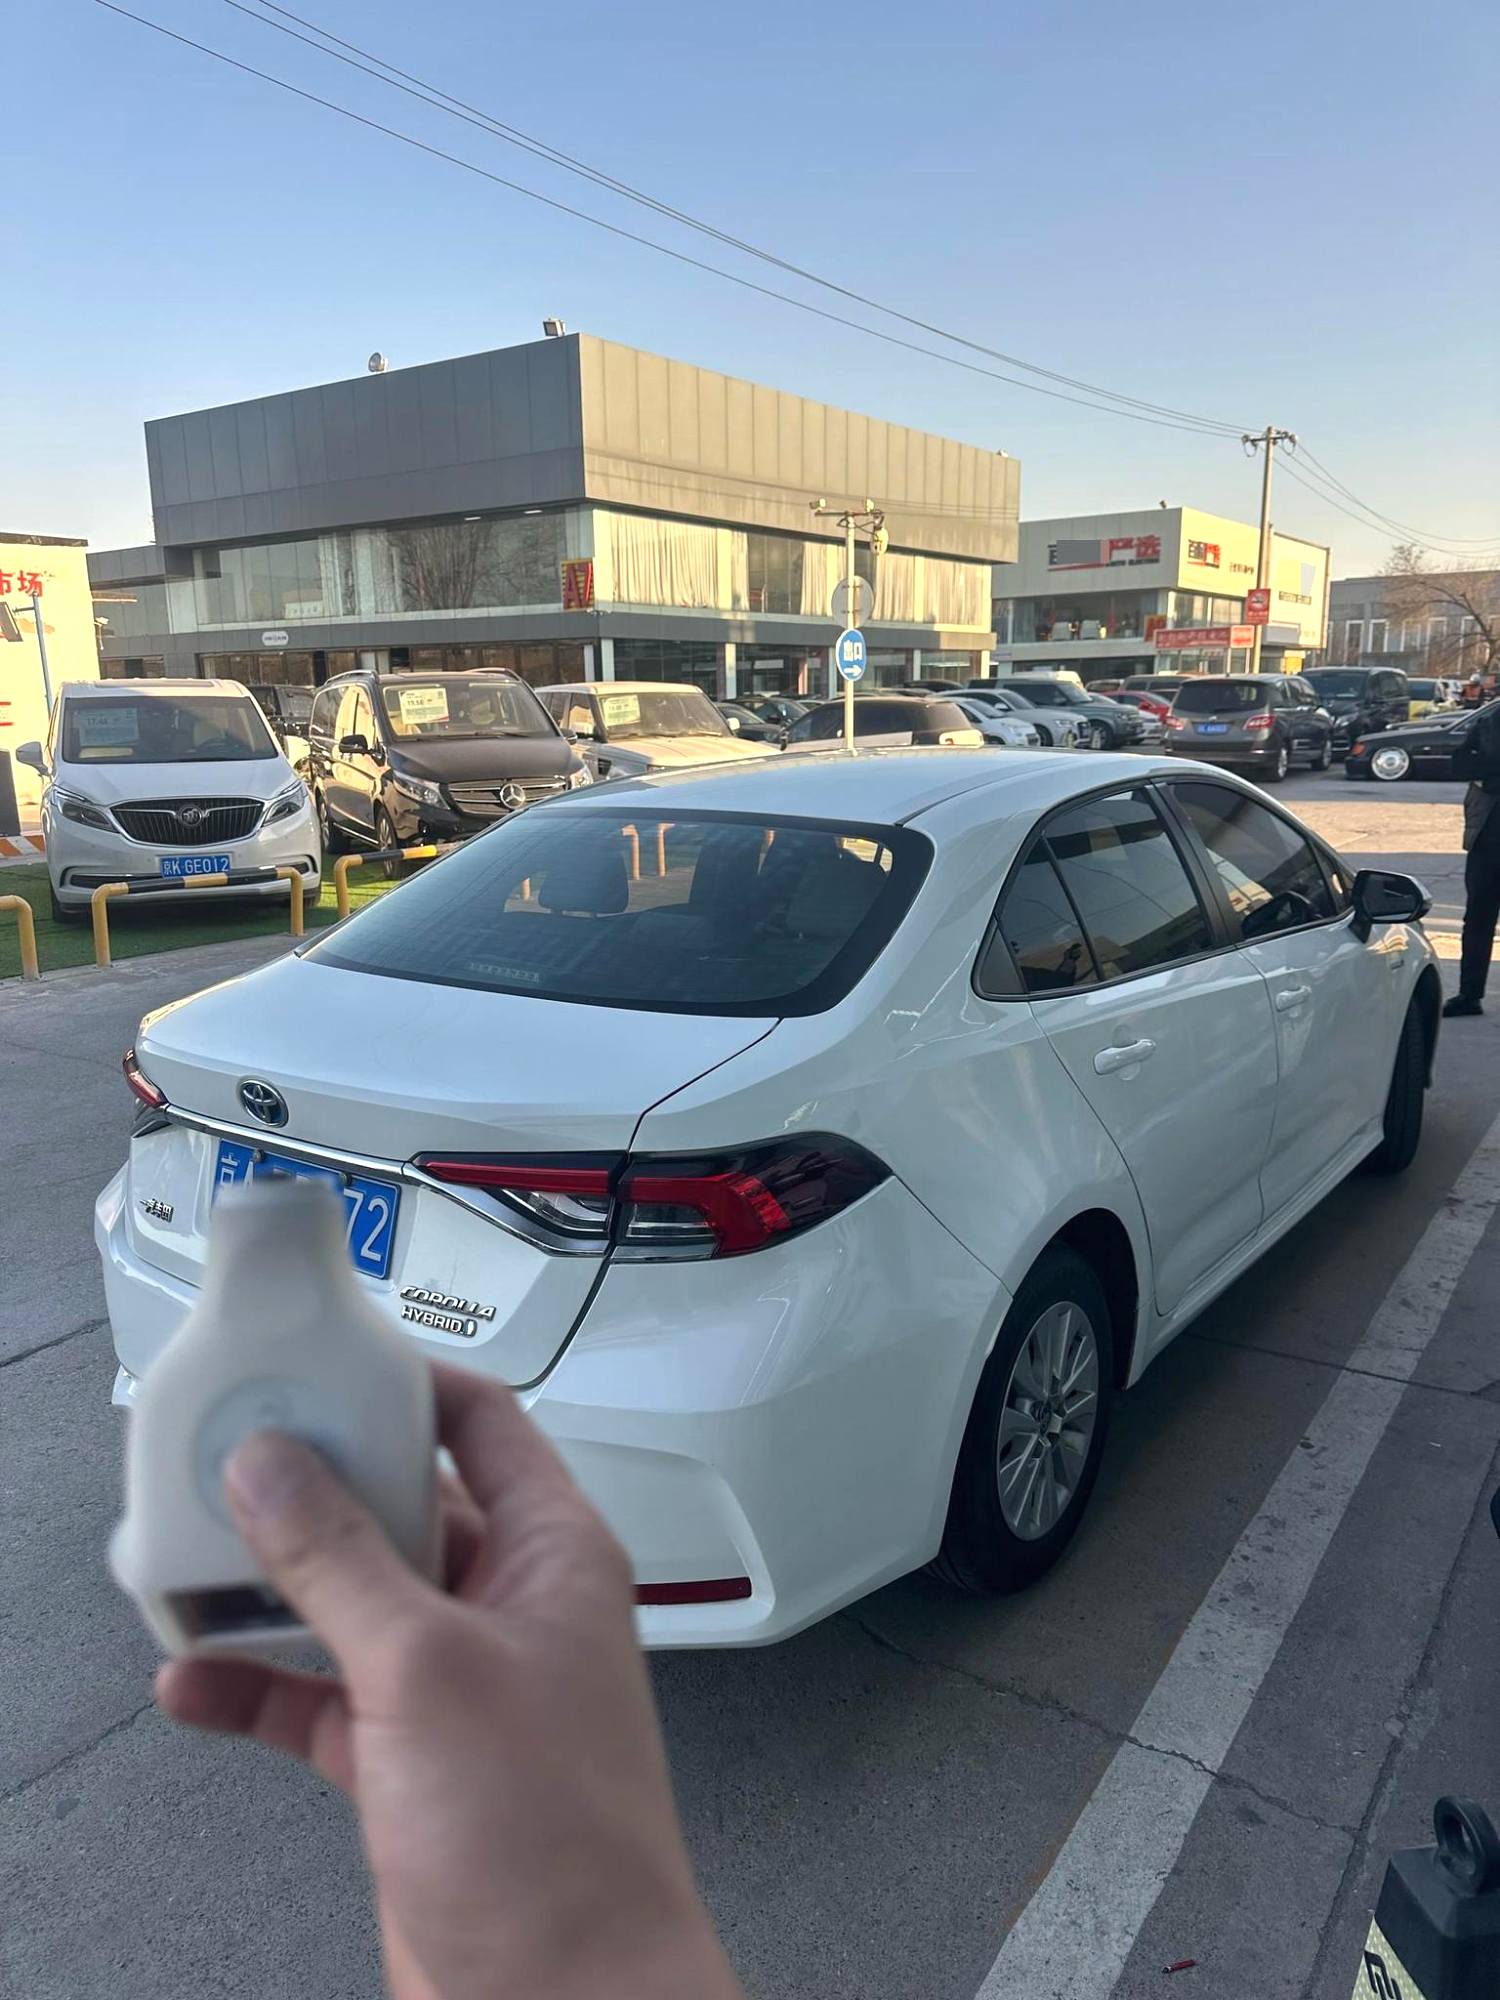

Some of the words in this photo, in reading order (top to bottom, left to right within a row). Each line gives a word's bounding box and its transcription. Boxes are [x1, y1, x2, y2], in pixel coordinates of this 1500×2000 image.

[843, 639, 863, 662] 出口
[400, 1286, 496, 1321] COROLLA
[401, 1304, 464, 1334] HYBRID
